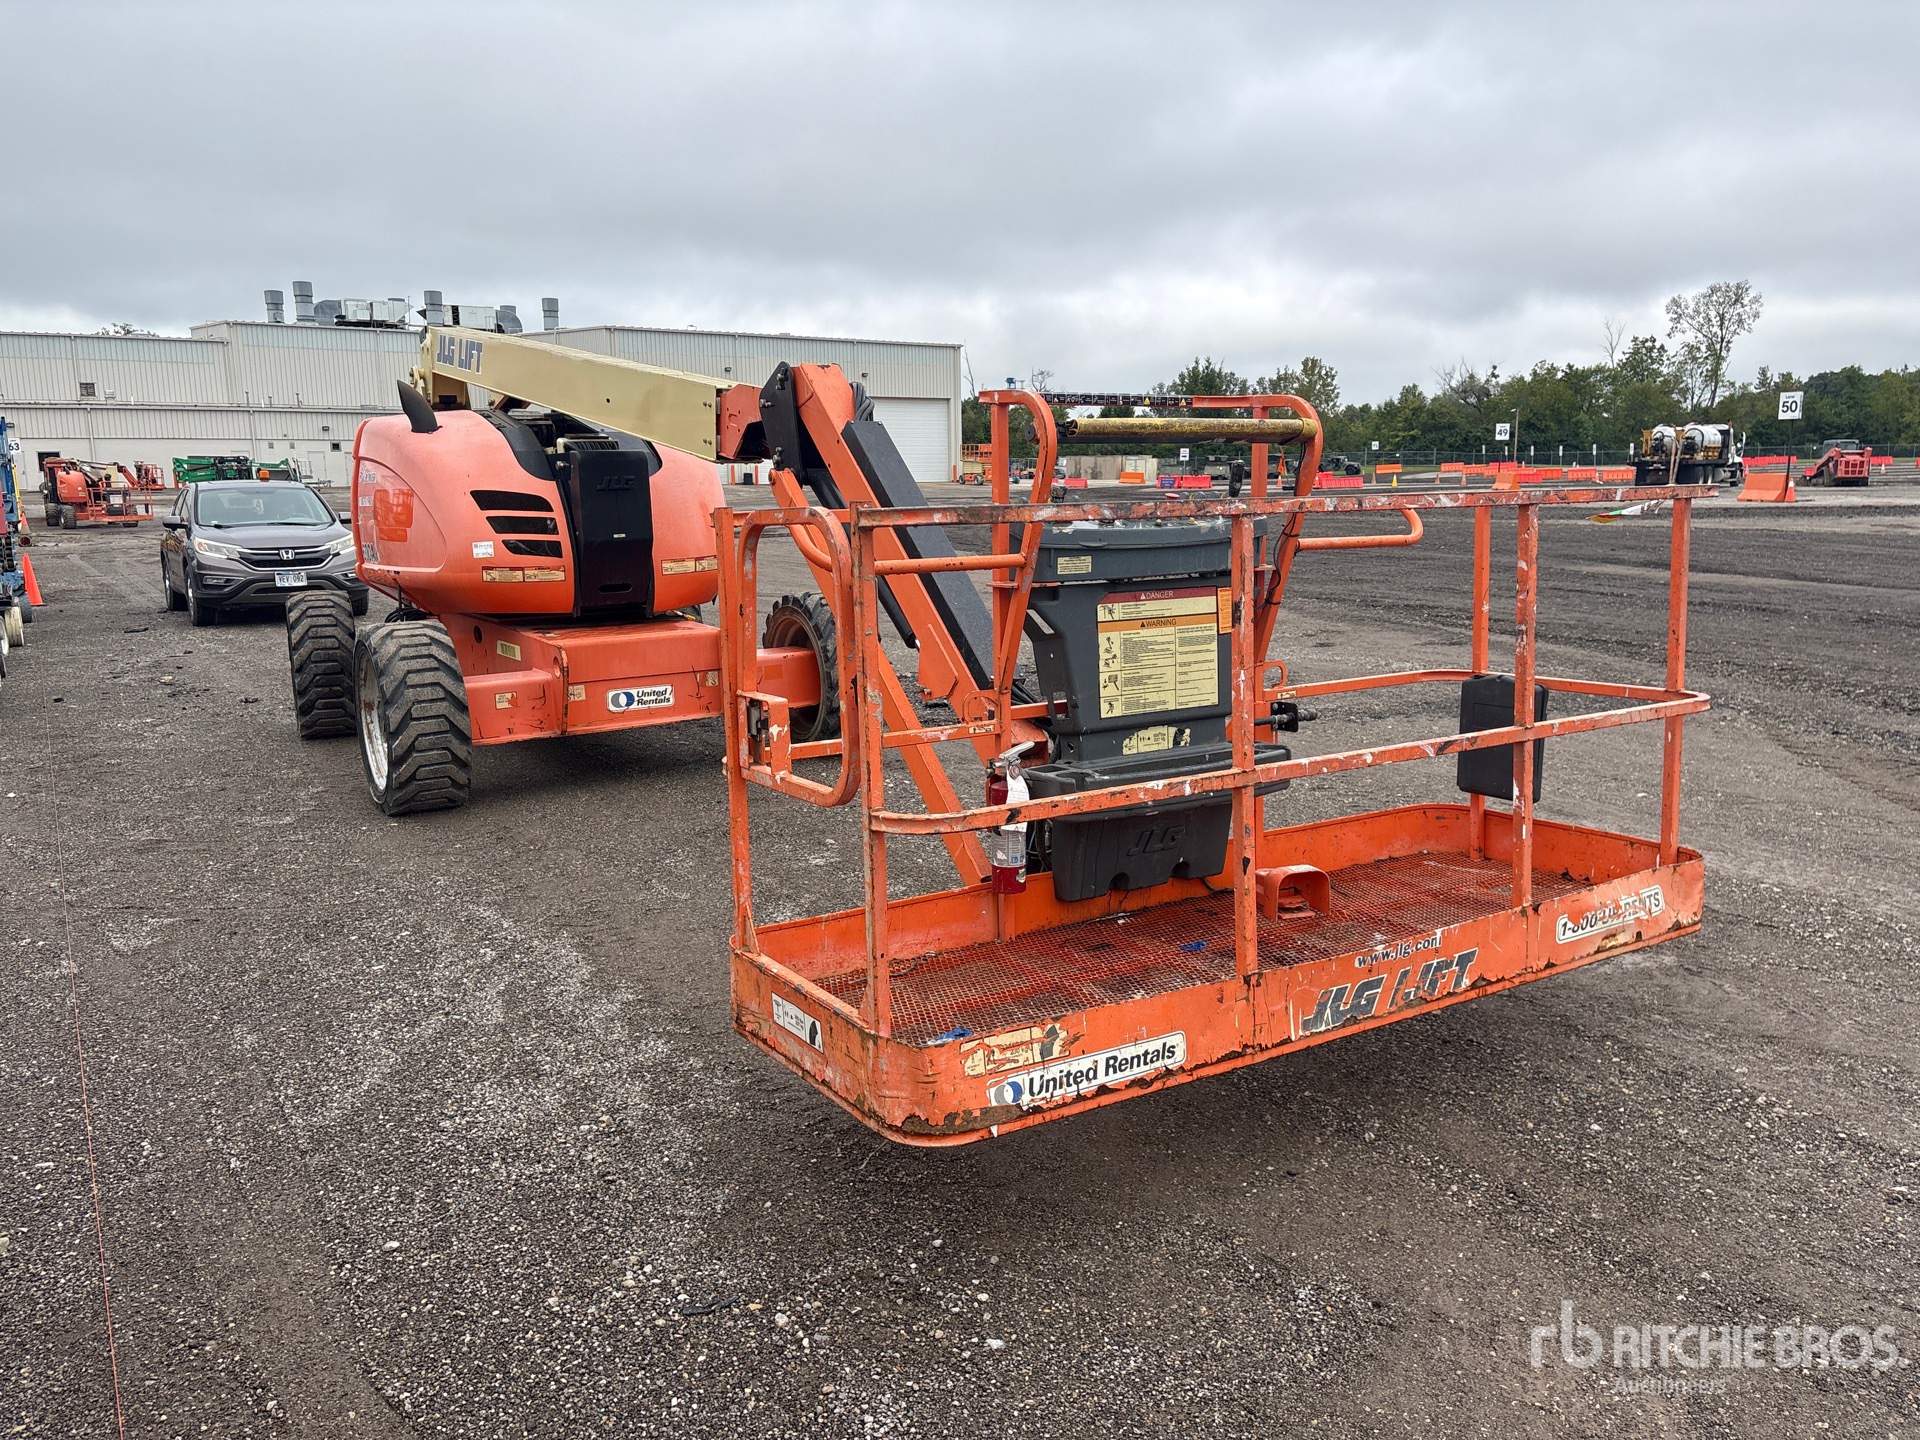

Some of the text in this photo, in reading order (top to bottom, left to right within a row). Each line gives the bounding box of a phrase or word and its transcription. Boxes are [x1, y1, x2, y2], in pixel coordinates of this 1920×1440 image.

[436, 334, 483, 373] JLG LIFT
[1781, 400, 1798, 413] 50
[1497, 428, 1508, 436] 49
[8, 442, 20, 451] 63
[1145, 590, 1175, 600] DANGER
[1145, 618, 1177, 627] WARNING
[636, 687, 668, 698] United
[636, 696, 671, 706] Rentals
[1126, 825, 1187, 857] JLG
[1301, 975, 1388, 1034] JLG
[1028, 1042, 1176, 1097] United Rentals
